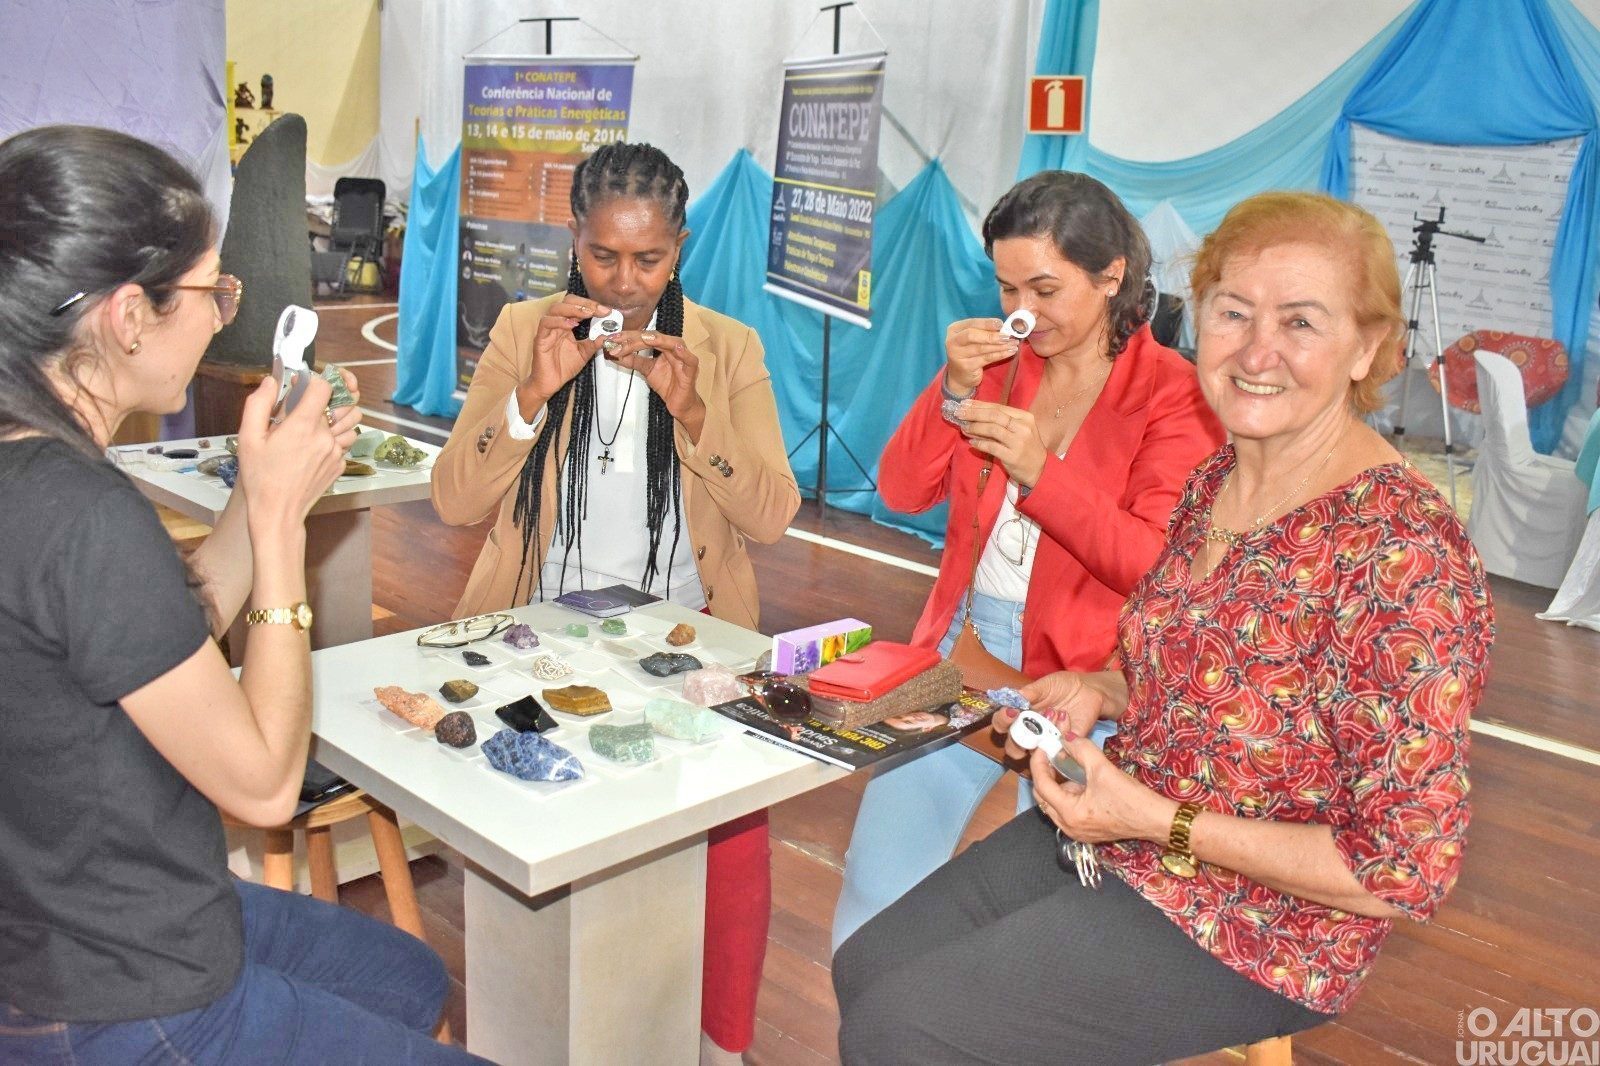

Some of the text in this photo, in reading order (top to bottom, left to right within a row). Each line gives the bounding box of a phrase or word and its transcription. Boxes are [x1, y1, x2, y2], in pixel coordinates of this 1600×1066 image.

[525, 71, 577, 83] CONATEPE
[481, 86, 613, 101] Conferência Nacional de
[468, 104, 626, 122] Teorias e Práticas Energéticas
[789, 102, 872, 141] CONATEPE
[467, 123, 625, 143] 13, 14 e 15 de maio de 2016
[791, 187, 872, 224] 27, 28 de Maio 2022
